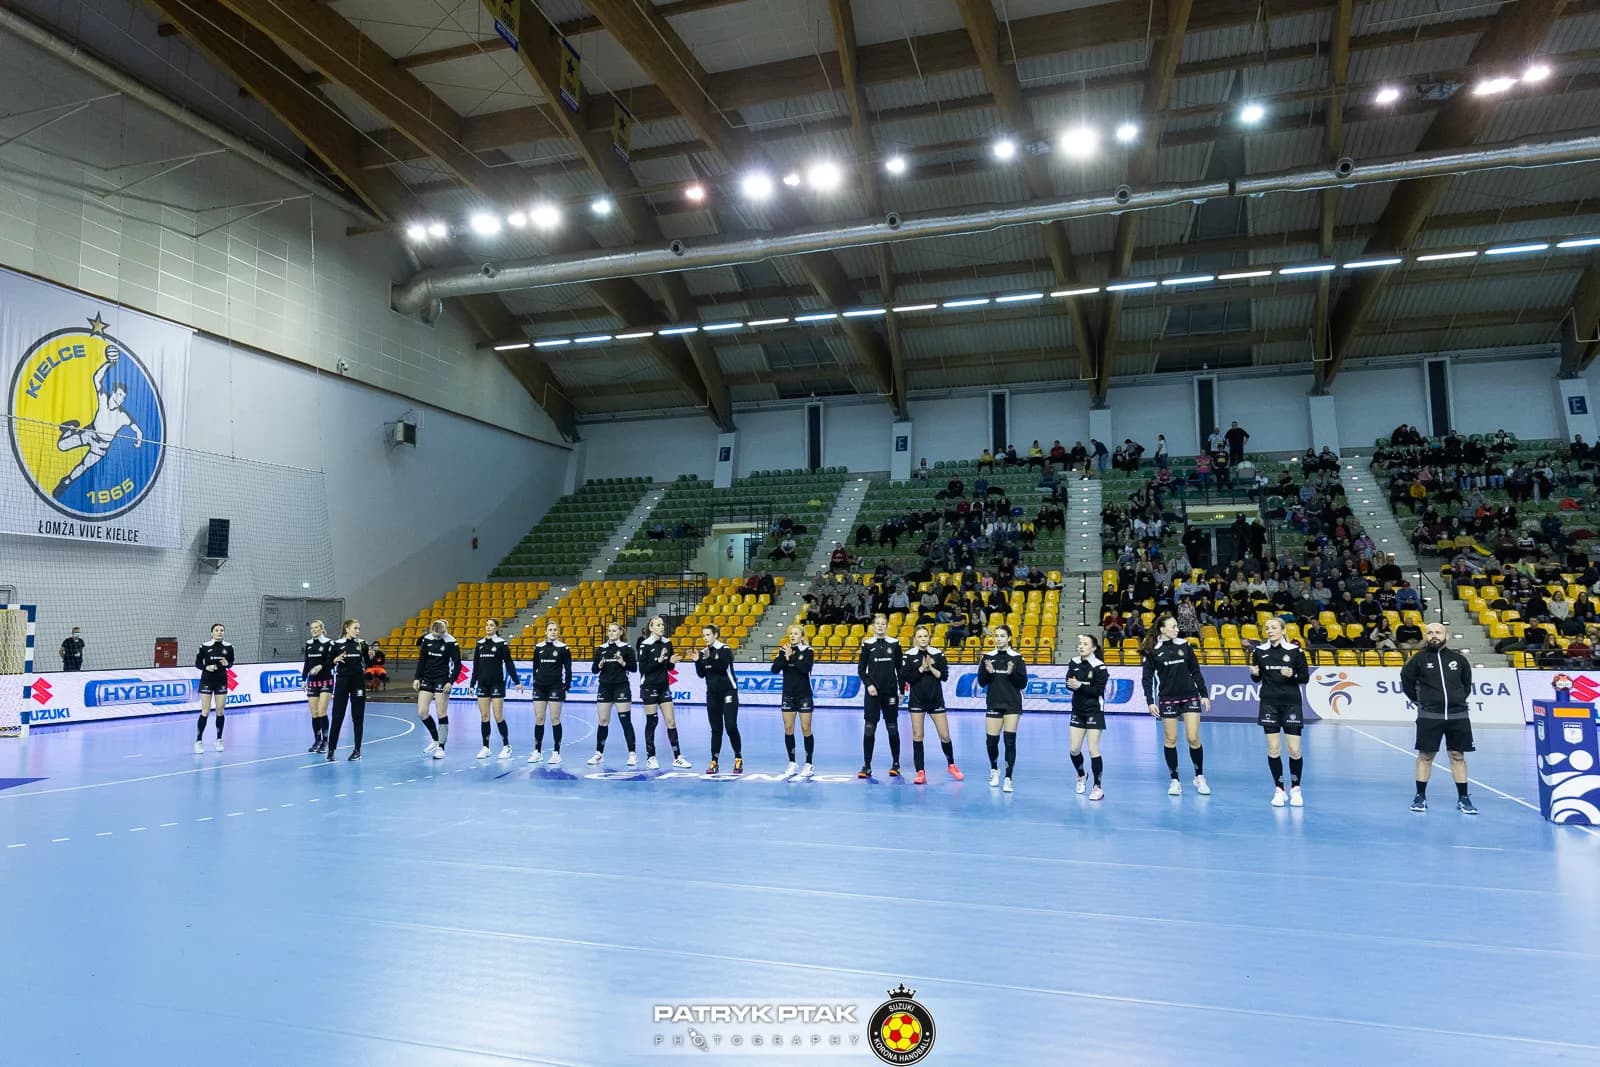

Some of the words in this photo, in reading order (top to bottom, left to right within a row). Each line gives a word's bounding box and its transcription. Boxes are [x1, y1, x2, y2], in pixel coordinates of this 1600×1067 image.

[25, 344, 87, 399] KIELCE
[86, 477, 135, 505] 1965
[38, 519, 75, 537] ŁOMŻA
[79, 523, 102, 539] VIVE
[105, 527, 140, 542] KIELCE
[103, 683, 187, 702] HYBRID
[29, 707, 71, 721] UZUKI
